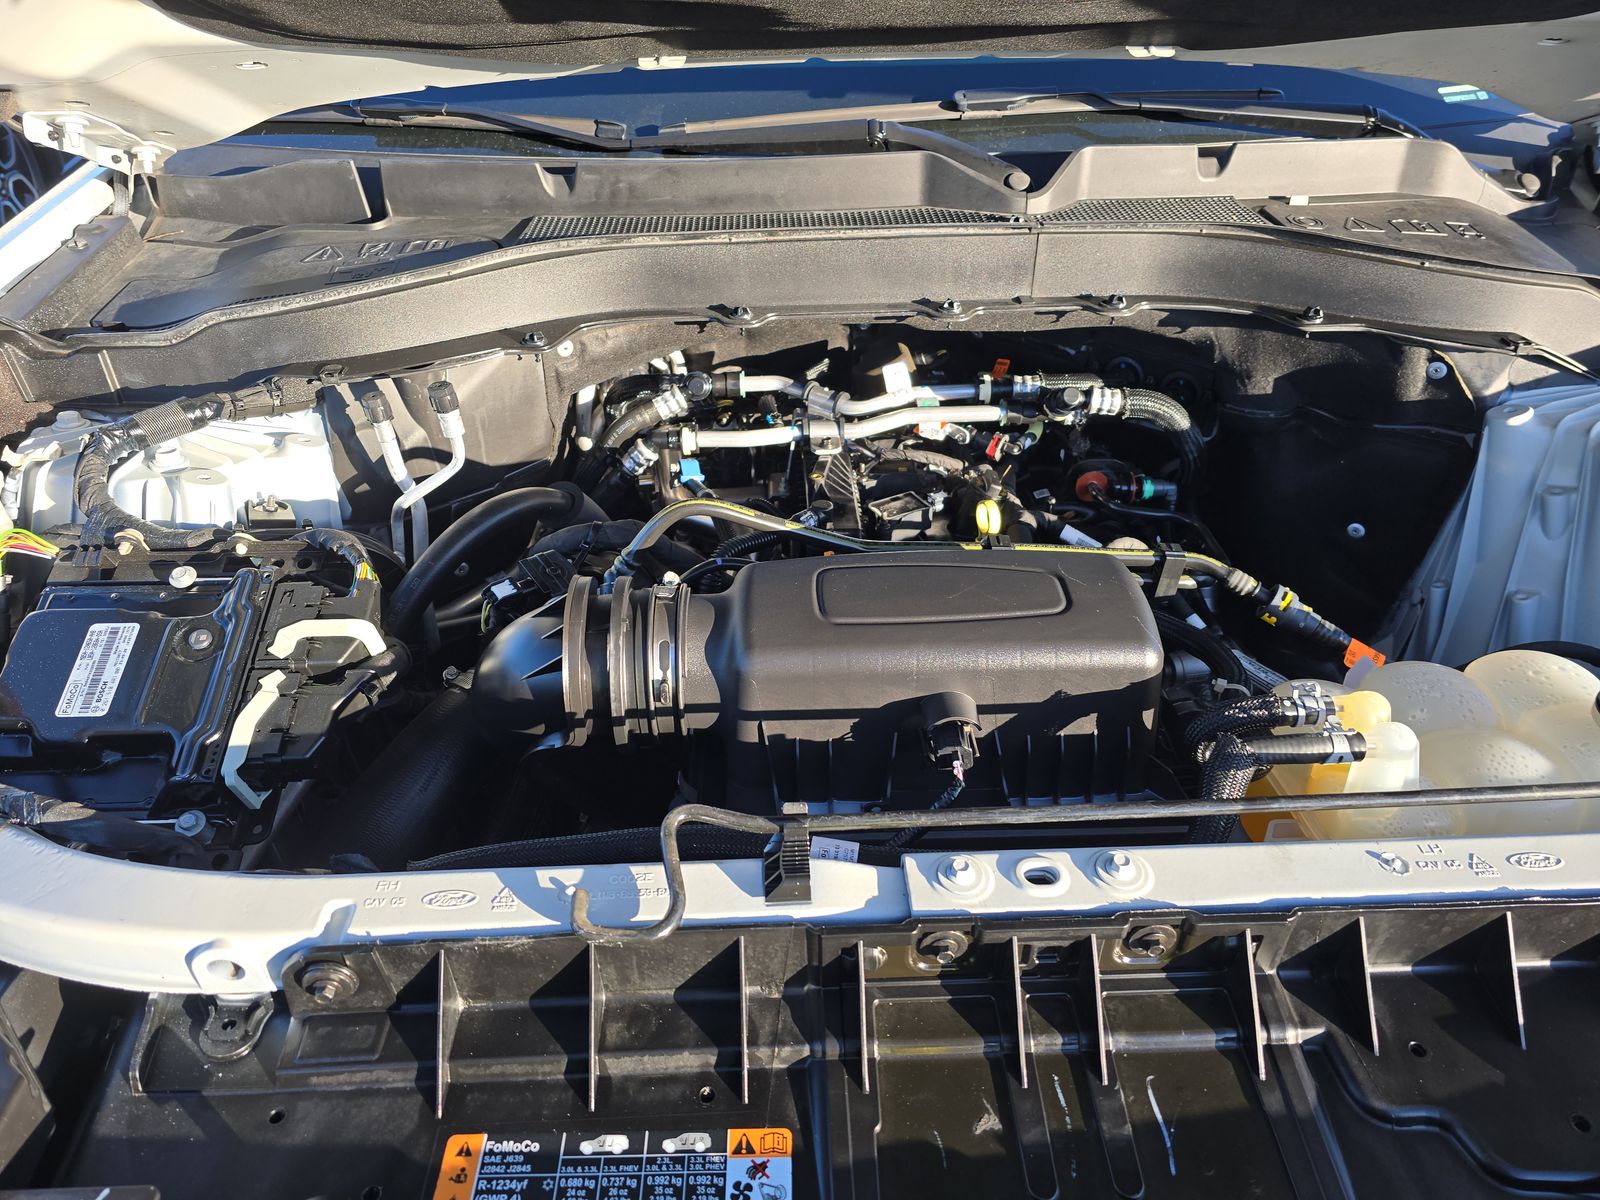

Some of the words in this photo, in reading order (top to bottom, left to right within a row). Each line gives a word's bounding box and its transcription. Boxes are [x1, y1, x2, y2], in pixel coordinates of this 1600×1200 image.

[96, 681, 108, 703] BOSCH
[62, 684, 79, 714] FoMoCo
[376, 880, 401, 891] RH
[485, 1140, 540, 1152] FoMoCo
[484, 1155, 501, 1163] SAE
[503, 1155, 524, 1163] J639
[706, 1155, 725, 1163] FHEV
[481, 1165, 505, 1173] J2842
[477, 1179, 529, 1191] R-1234yf
[560, 1178, 582, 1187] 0.680
[584, 1177, 595, 1189] kg
[601, 1177, 624, 1187] 0.737
[625, 1176, 637, 1188] kg
[647, 1175, 670, 1185] 0.992
[671, 1175, 682, 1186] kg
[689, 1175, 712, 1185] 0.992
[713, 1174, 724, 1186] kg
[654, 1186, 663, 1194] 35
[696, 1186, 706, 1194] 35
